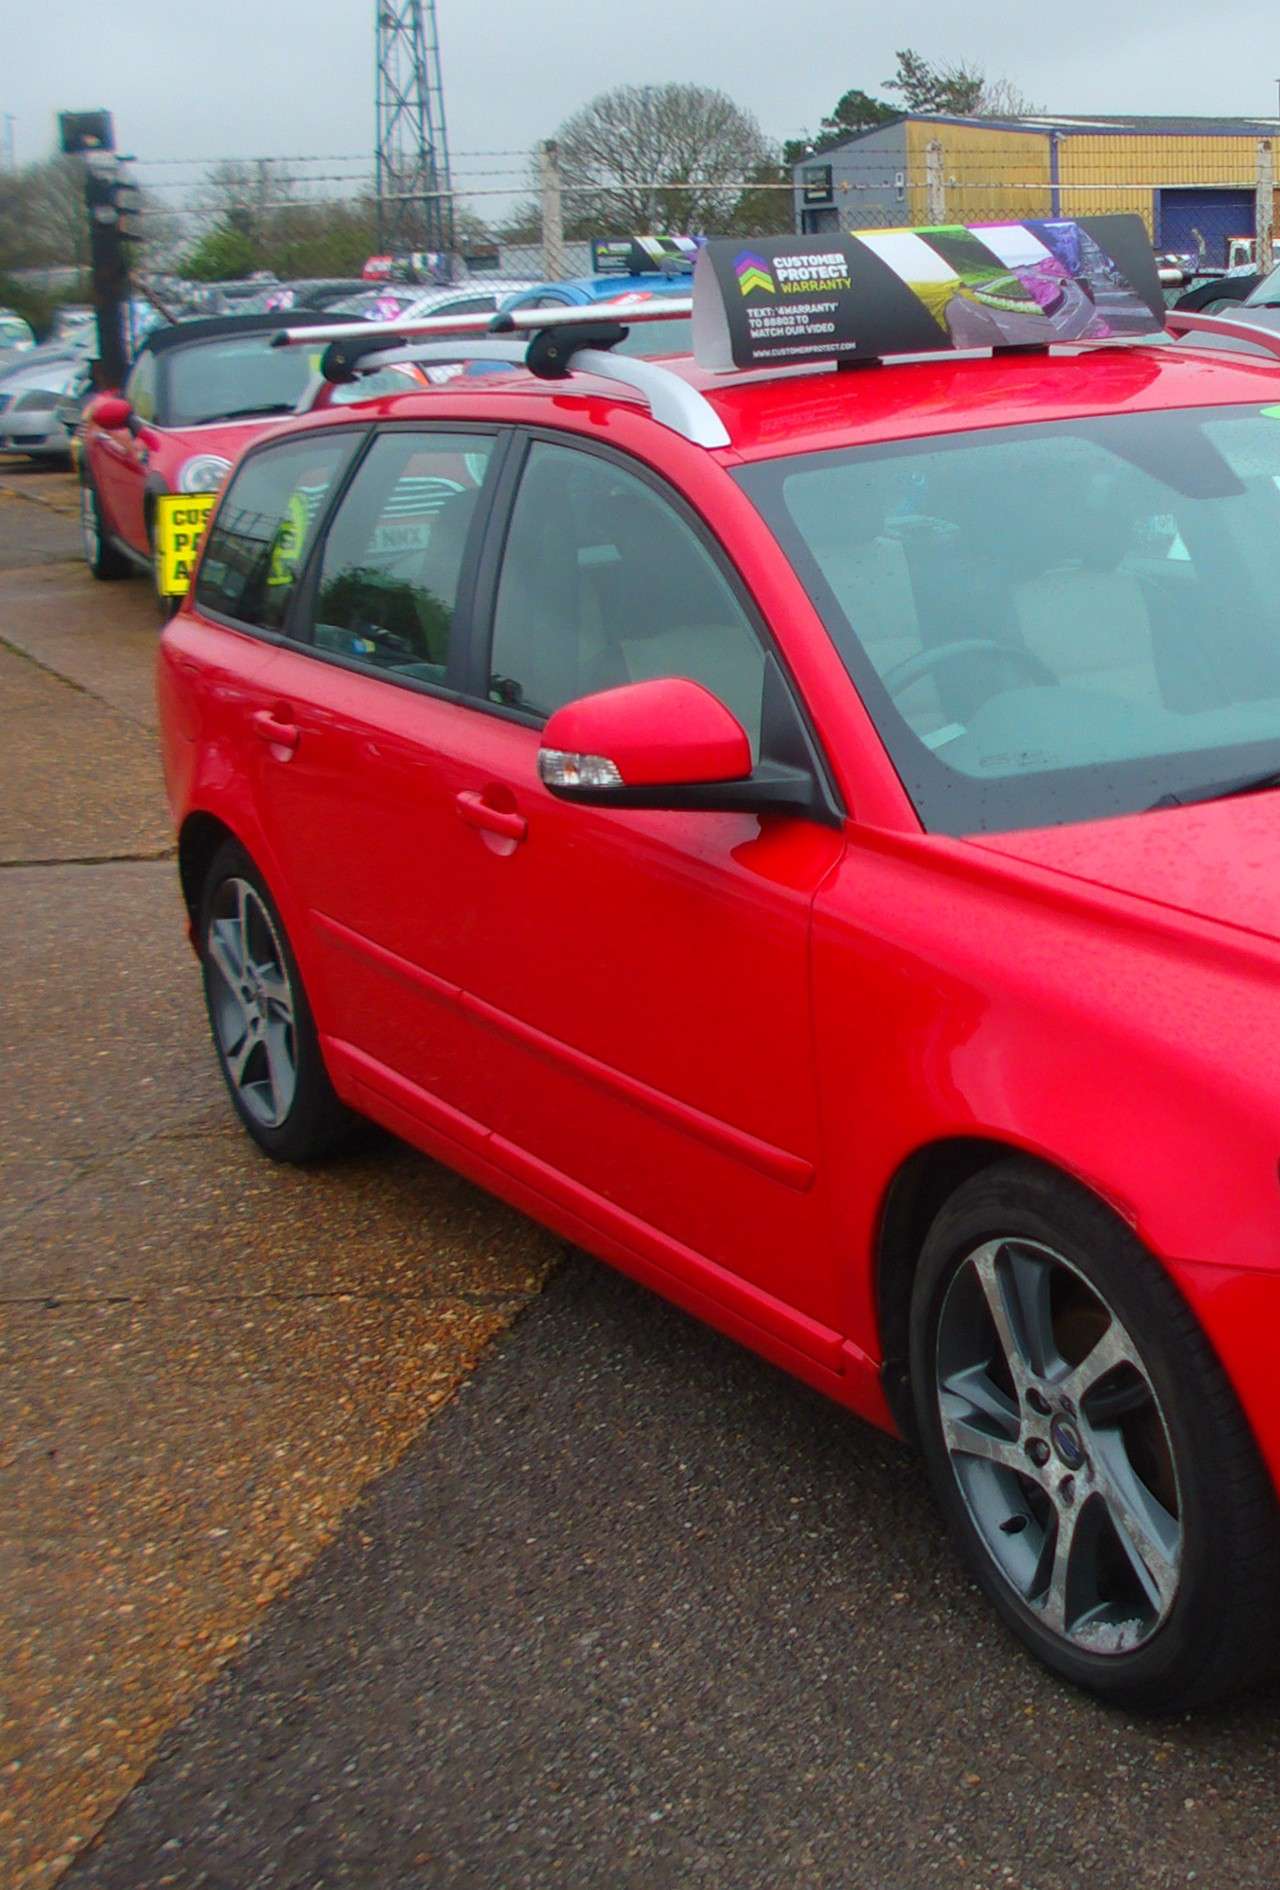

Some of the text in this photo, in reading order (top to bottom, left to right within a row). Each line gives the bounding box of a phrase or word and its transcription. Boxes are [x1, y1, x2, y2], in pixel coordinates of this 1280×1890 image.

[772, 253, 846, 268] CUSTOMER
[776, 264, 848, 281] PROTECT
[781, 278, 852, 293] WARRANTY
[749, 318, 762, 328] TO
[795, 314, 810, 324] TO
[750, 322, 836, 338] WATCH OUR VIDEO
